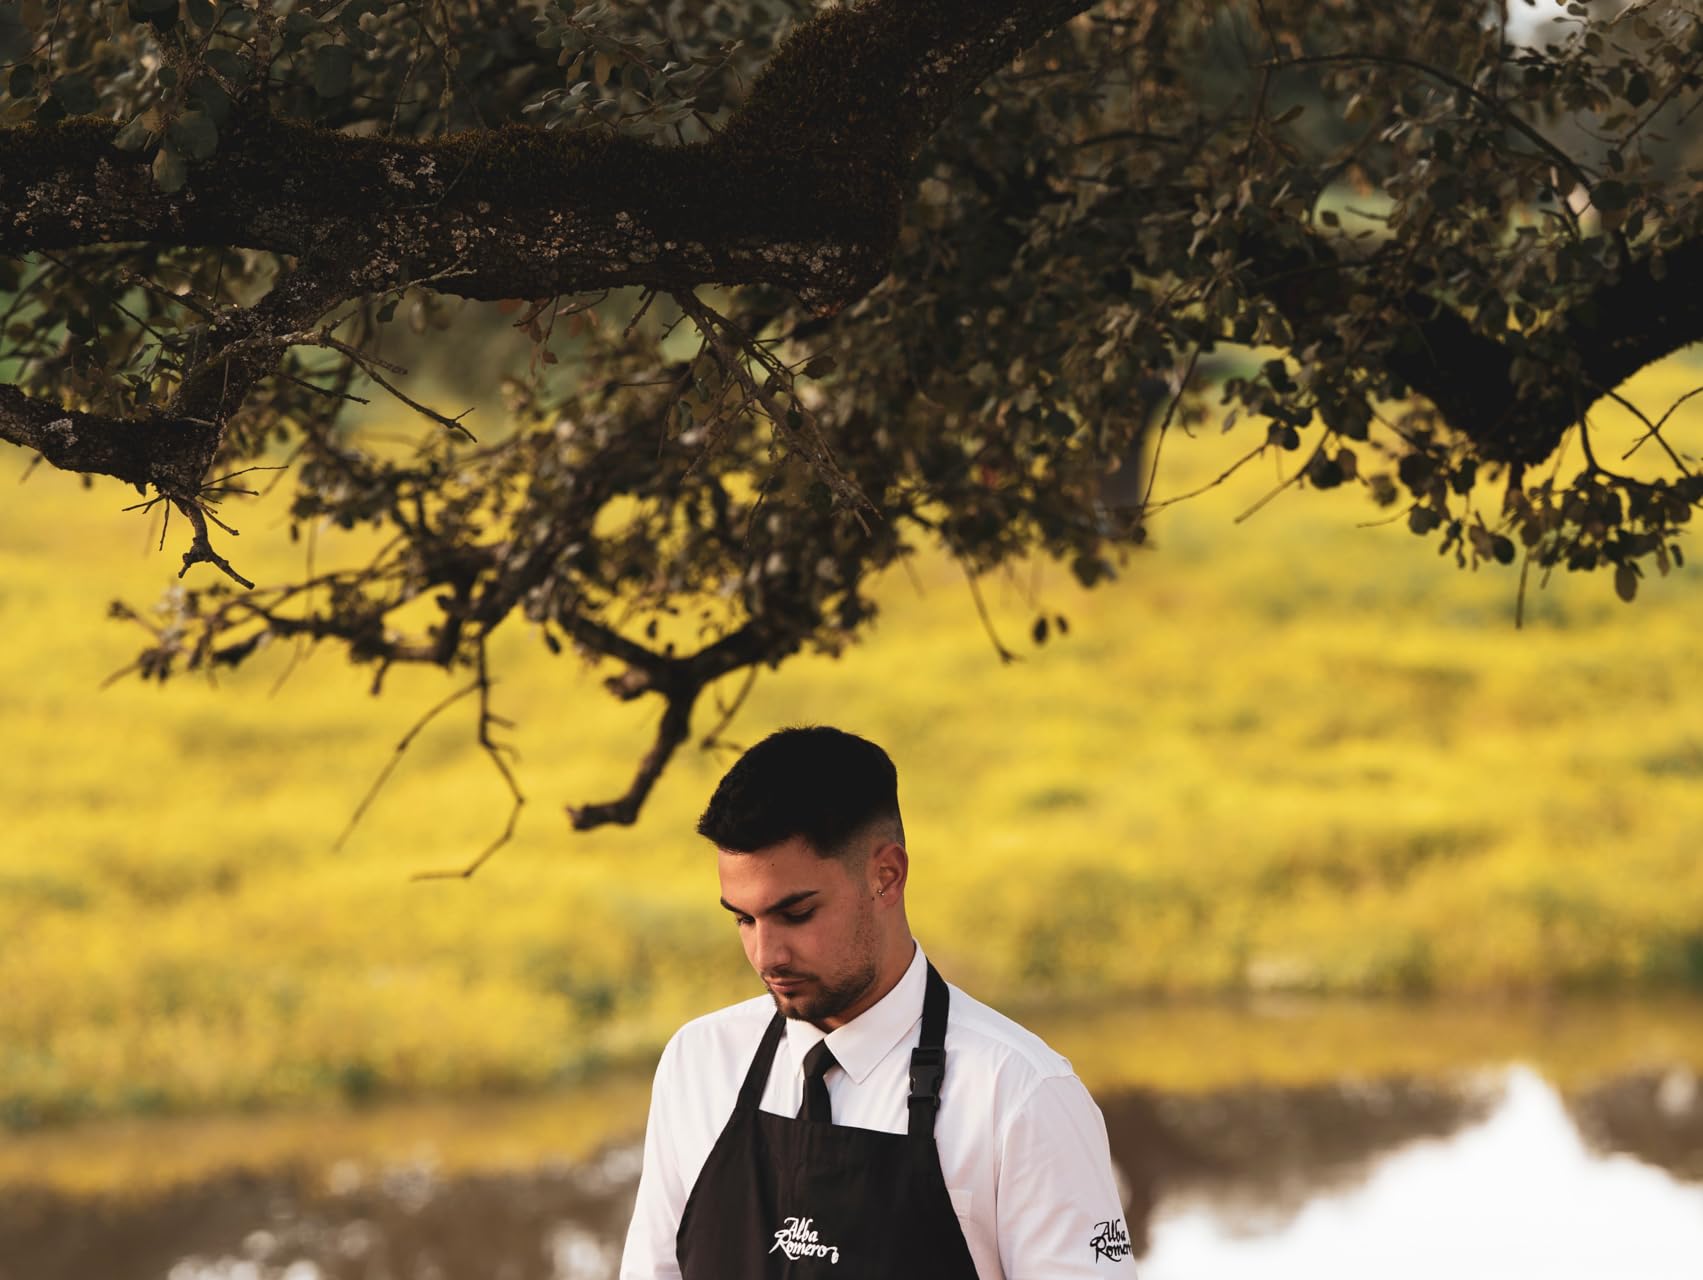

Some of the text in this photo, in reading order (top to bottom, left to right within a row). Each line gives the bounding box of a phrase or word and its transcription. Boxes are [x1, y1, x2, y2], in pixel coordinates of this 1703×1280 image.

[784, 1217, 819, 1242] Alba
[1093, 1218, 1126, 1243] Alba
[768, 1229, 838, 1260] Romero
[1089, 1236, 1131, 1264] Romer
